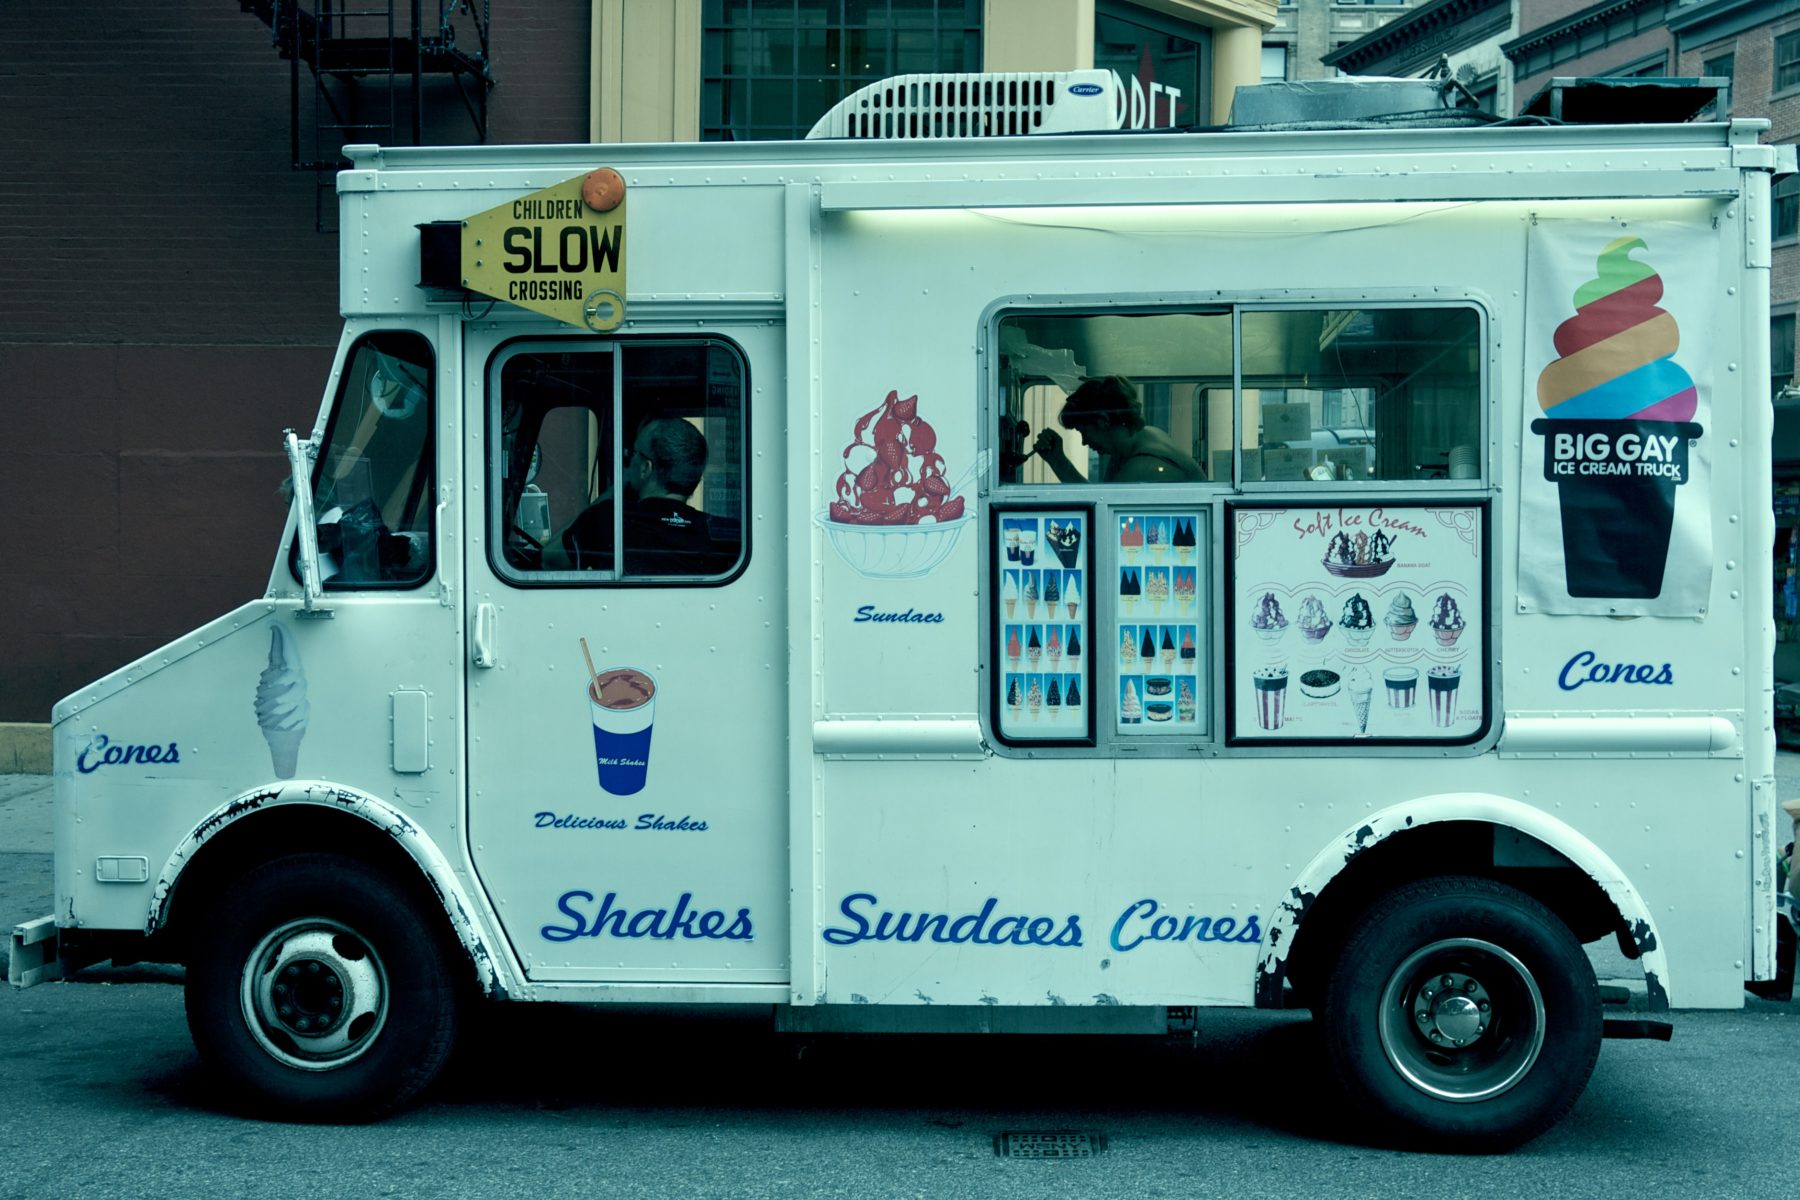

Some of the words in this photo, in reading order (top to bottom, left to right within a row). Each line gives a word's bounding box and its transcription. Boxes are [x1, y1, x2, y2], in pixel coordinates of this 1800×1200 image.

[1073, 86, 1099, 94] Carrier
[513, 199, 583, 220] CHILDREN
[503, 225, 623, 274] SLOW
[509, 280, 583, 301] CROSSING
[1554, 433, 1610, 461] BIG
[1615, 433, 1679, 462] GAY
[1553, 461, 1576, 475] ICE
[1579, 462, 1631, 476] CREAM
[1635, 463, 1681, 477] TRUCK
[1293, 511, 1332, 540] Soft
[1338, 507, 1362, 527] Ice
[1367, 507, 1428, 539] Cream
[853, 605, 945, 624] Sundaes
[1558, 651, 1673, 691] Cones
[77, 734, 180, 774] Cones
[598, 757, 618, 765] Milk
[619, 757, 646, 766] Shakes
[534, 811, 628, 830] Delicious
[634, 813, 709, 832] Shakes
[541, 891, 754, 943] Shakes
[823, 894, 1083, 947] Sundaes
[1110, 898, 1262, 952] Cones
